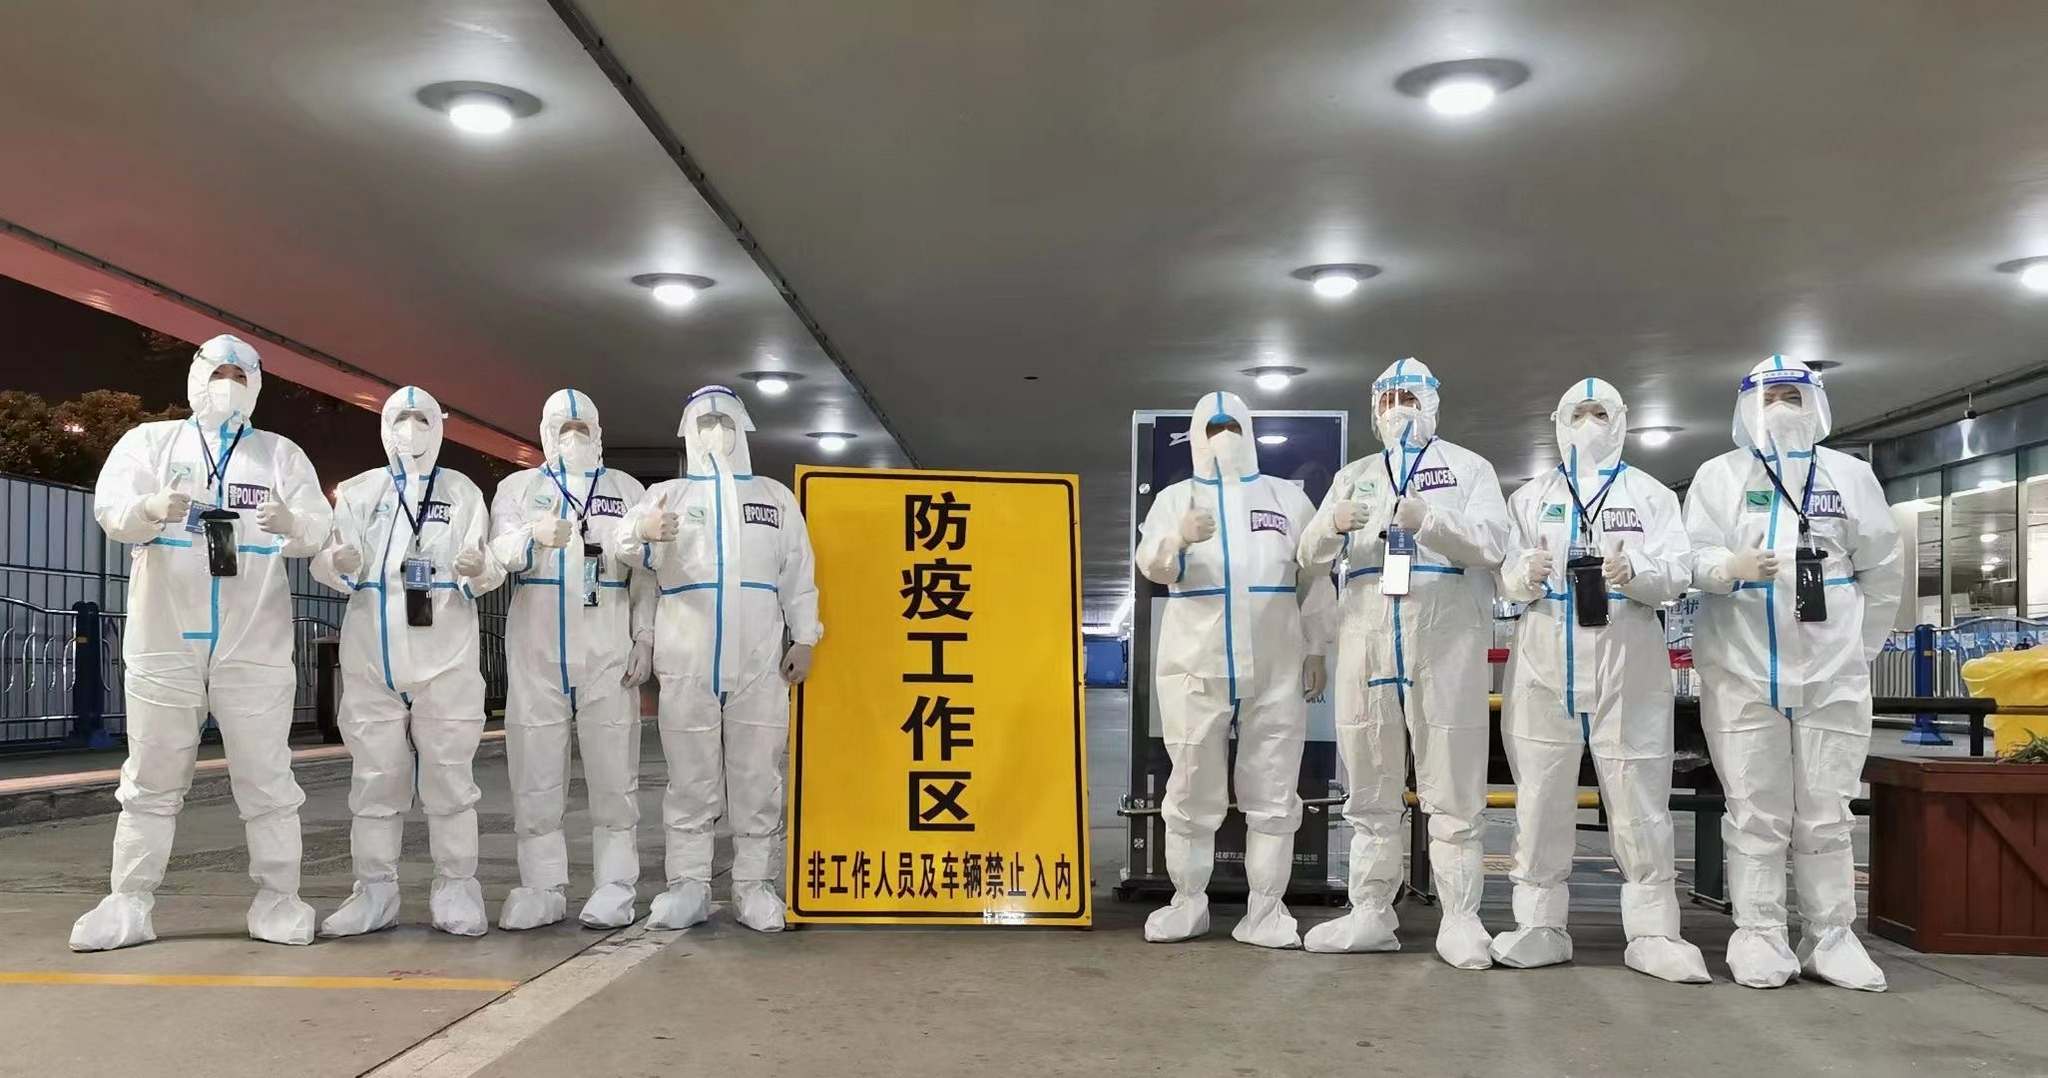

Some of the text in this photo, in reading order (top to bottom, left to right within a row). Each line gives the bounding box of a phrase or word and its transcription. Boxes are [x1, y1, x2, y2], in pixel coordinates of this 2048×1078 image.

[900, 491, 976, 832] 防疫工作区
[807, 849, 1072, 900] 非工作人员及车辆禁止入内
